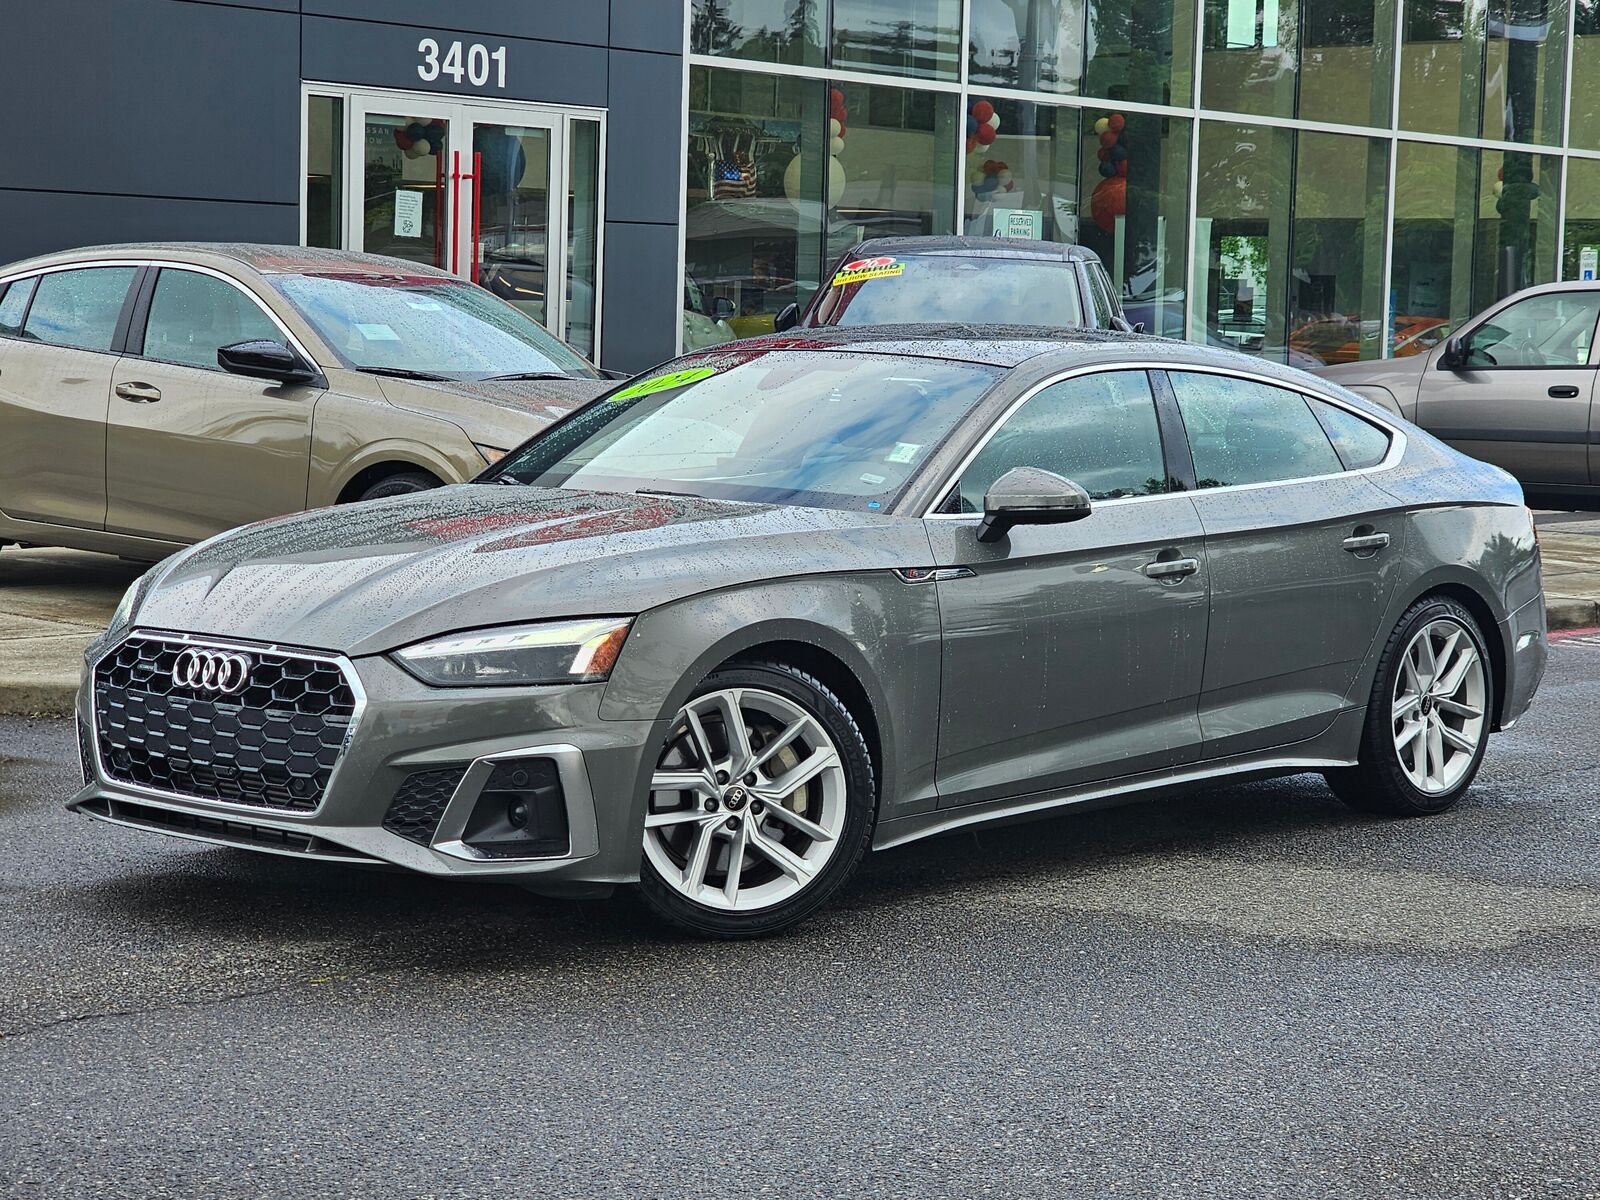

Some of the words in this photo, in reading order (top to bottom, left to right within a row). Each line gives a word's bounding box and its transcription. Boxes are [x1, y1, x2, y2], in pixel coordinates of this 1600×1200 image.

[417, 38, 506, 88] 3401
[366, 127, 389, 135] SSAN
[1010, 217, 1032, 226] RESERVED
[1010, 228, 1031, 237] PARKING
[842, 263, 900, 277] HYBRID
